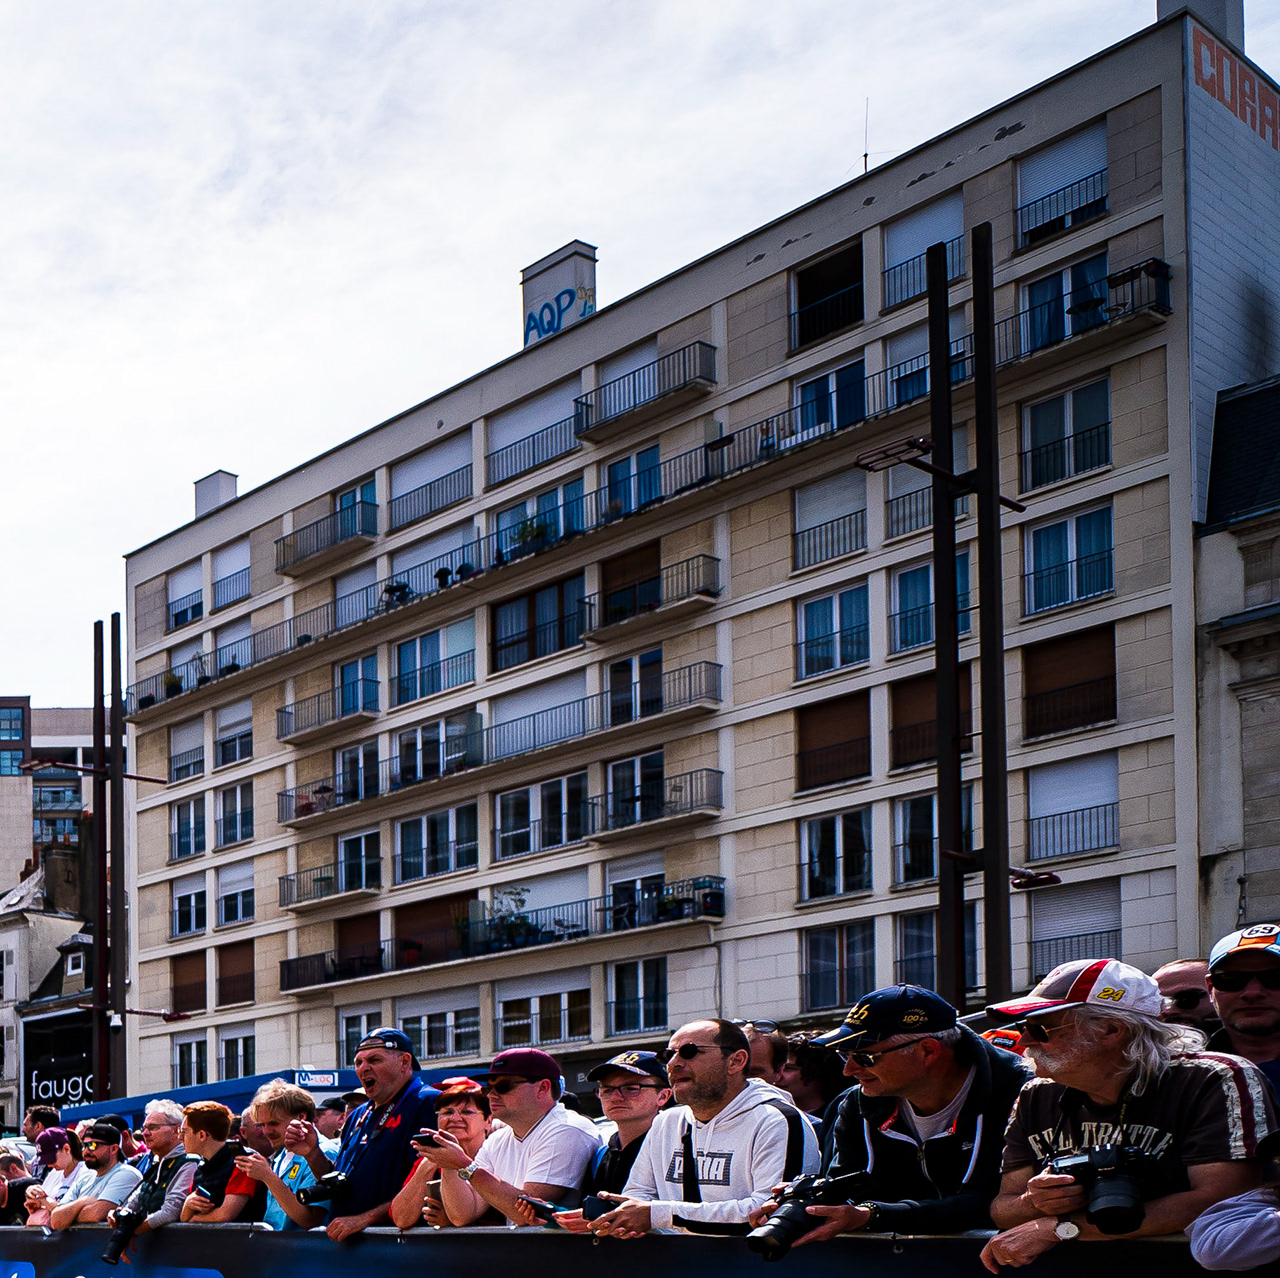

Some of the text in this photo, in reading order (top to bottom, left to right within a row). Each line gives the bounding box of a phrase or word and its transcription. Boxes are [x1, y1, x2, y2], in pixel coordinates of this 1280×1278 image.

[524, 288, 577, 346] AQP
[1096, 987, 1125, 1002] 24
[673, 1157, 727, 1181] PMA
